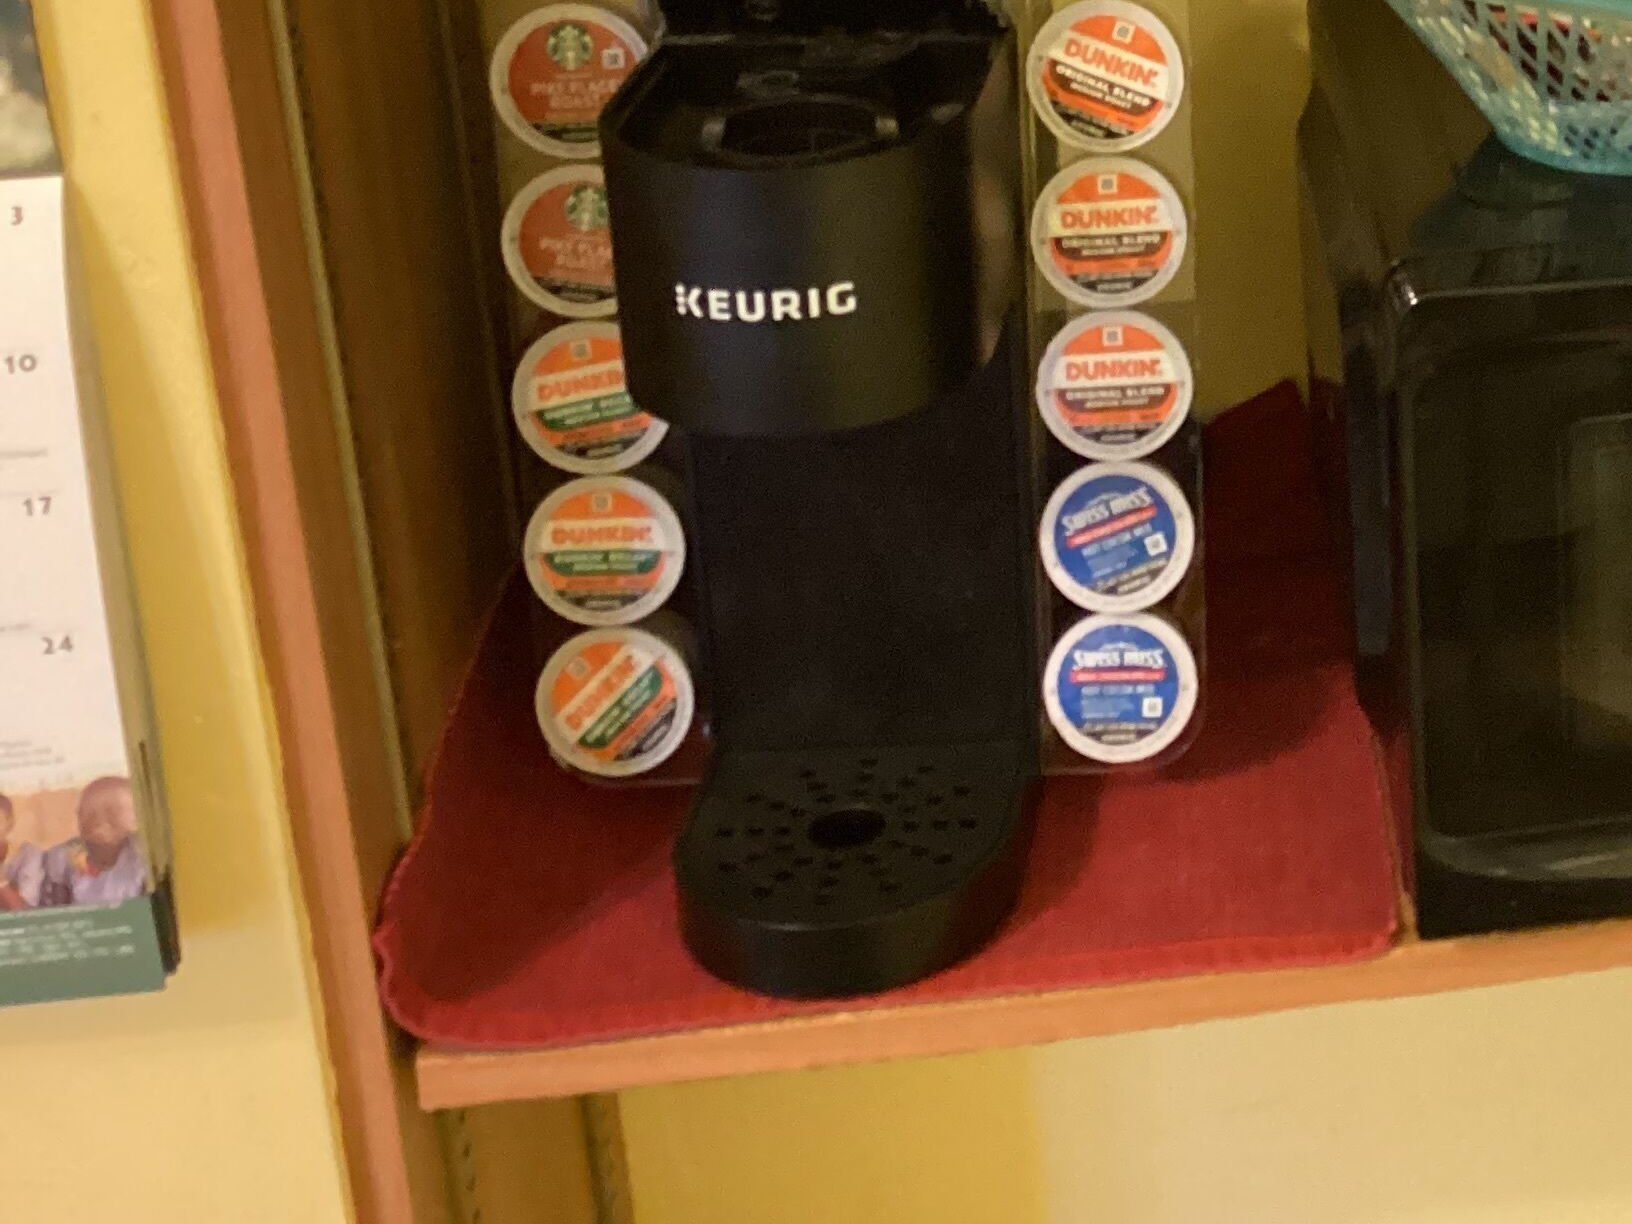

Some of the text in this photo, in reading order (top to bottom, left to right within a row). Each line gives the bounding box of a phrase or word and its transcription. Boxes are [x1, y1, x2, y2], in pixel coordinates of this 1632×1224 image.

[11, 206, 24, 226] 3
[674, 280, 858, 322] KEURIG
[5, 354, 38, 374] 10
[23, 495, 52, 516] 17
[41, 635, 74, 655] 24
